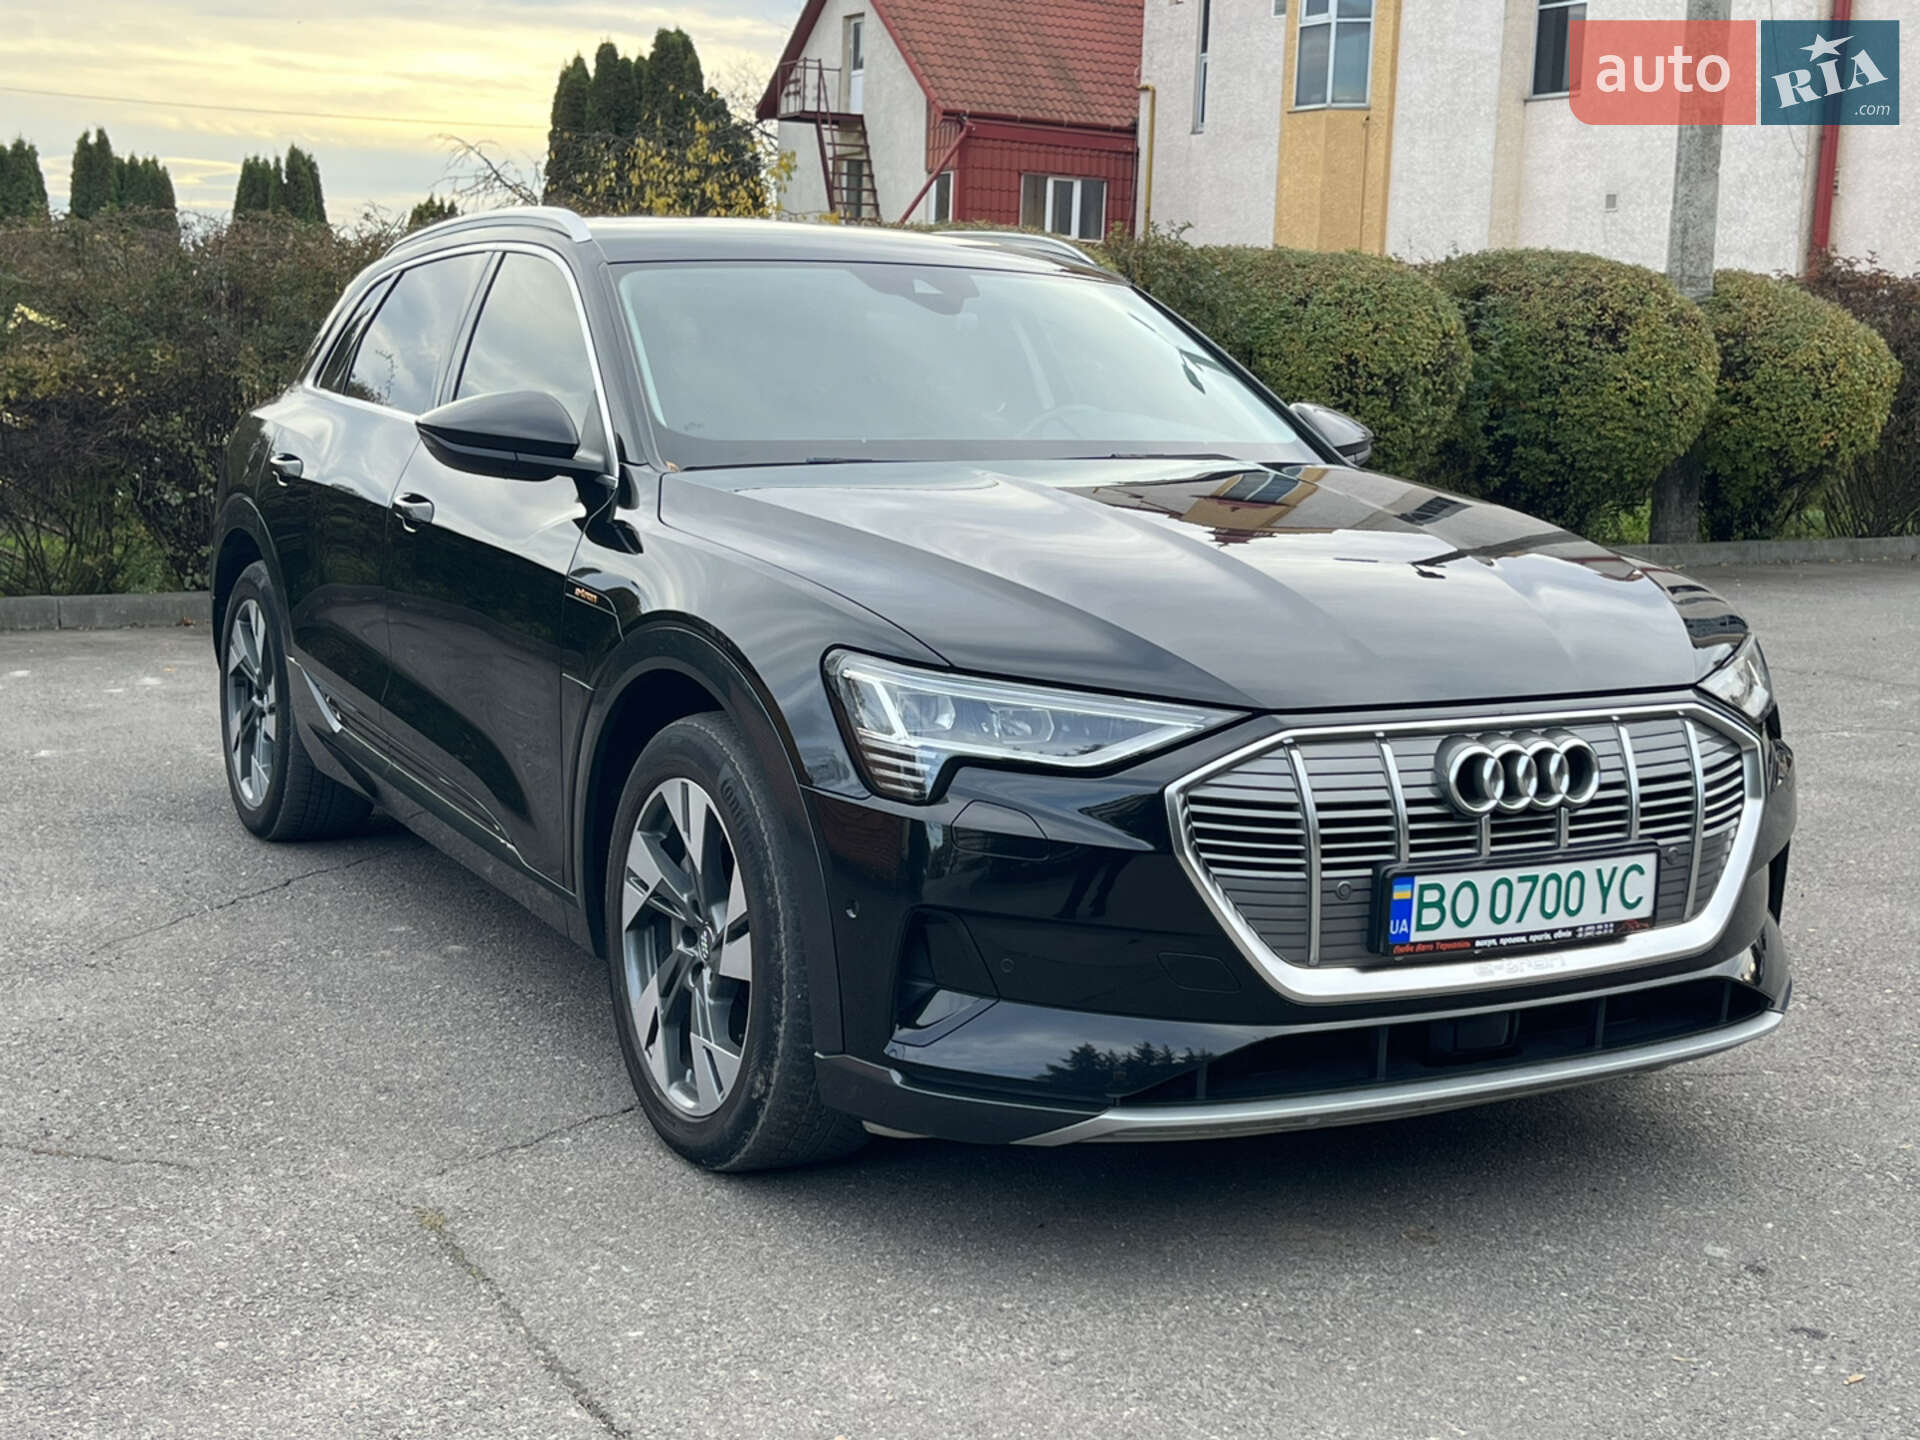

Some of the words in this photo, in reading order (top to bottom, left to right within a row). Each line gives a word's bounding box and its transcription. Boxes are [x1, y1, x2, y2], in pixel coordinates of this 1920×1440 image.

[1415, 880, 1480, 932] BO
[1489, 869, 1586, 925] 0700
[1595, 863, 1646, 915] YC
[1389, 919, 1409, 935] UA
